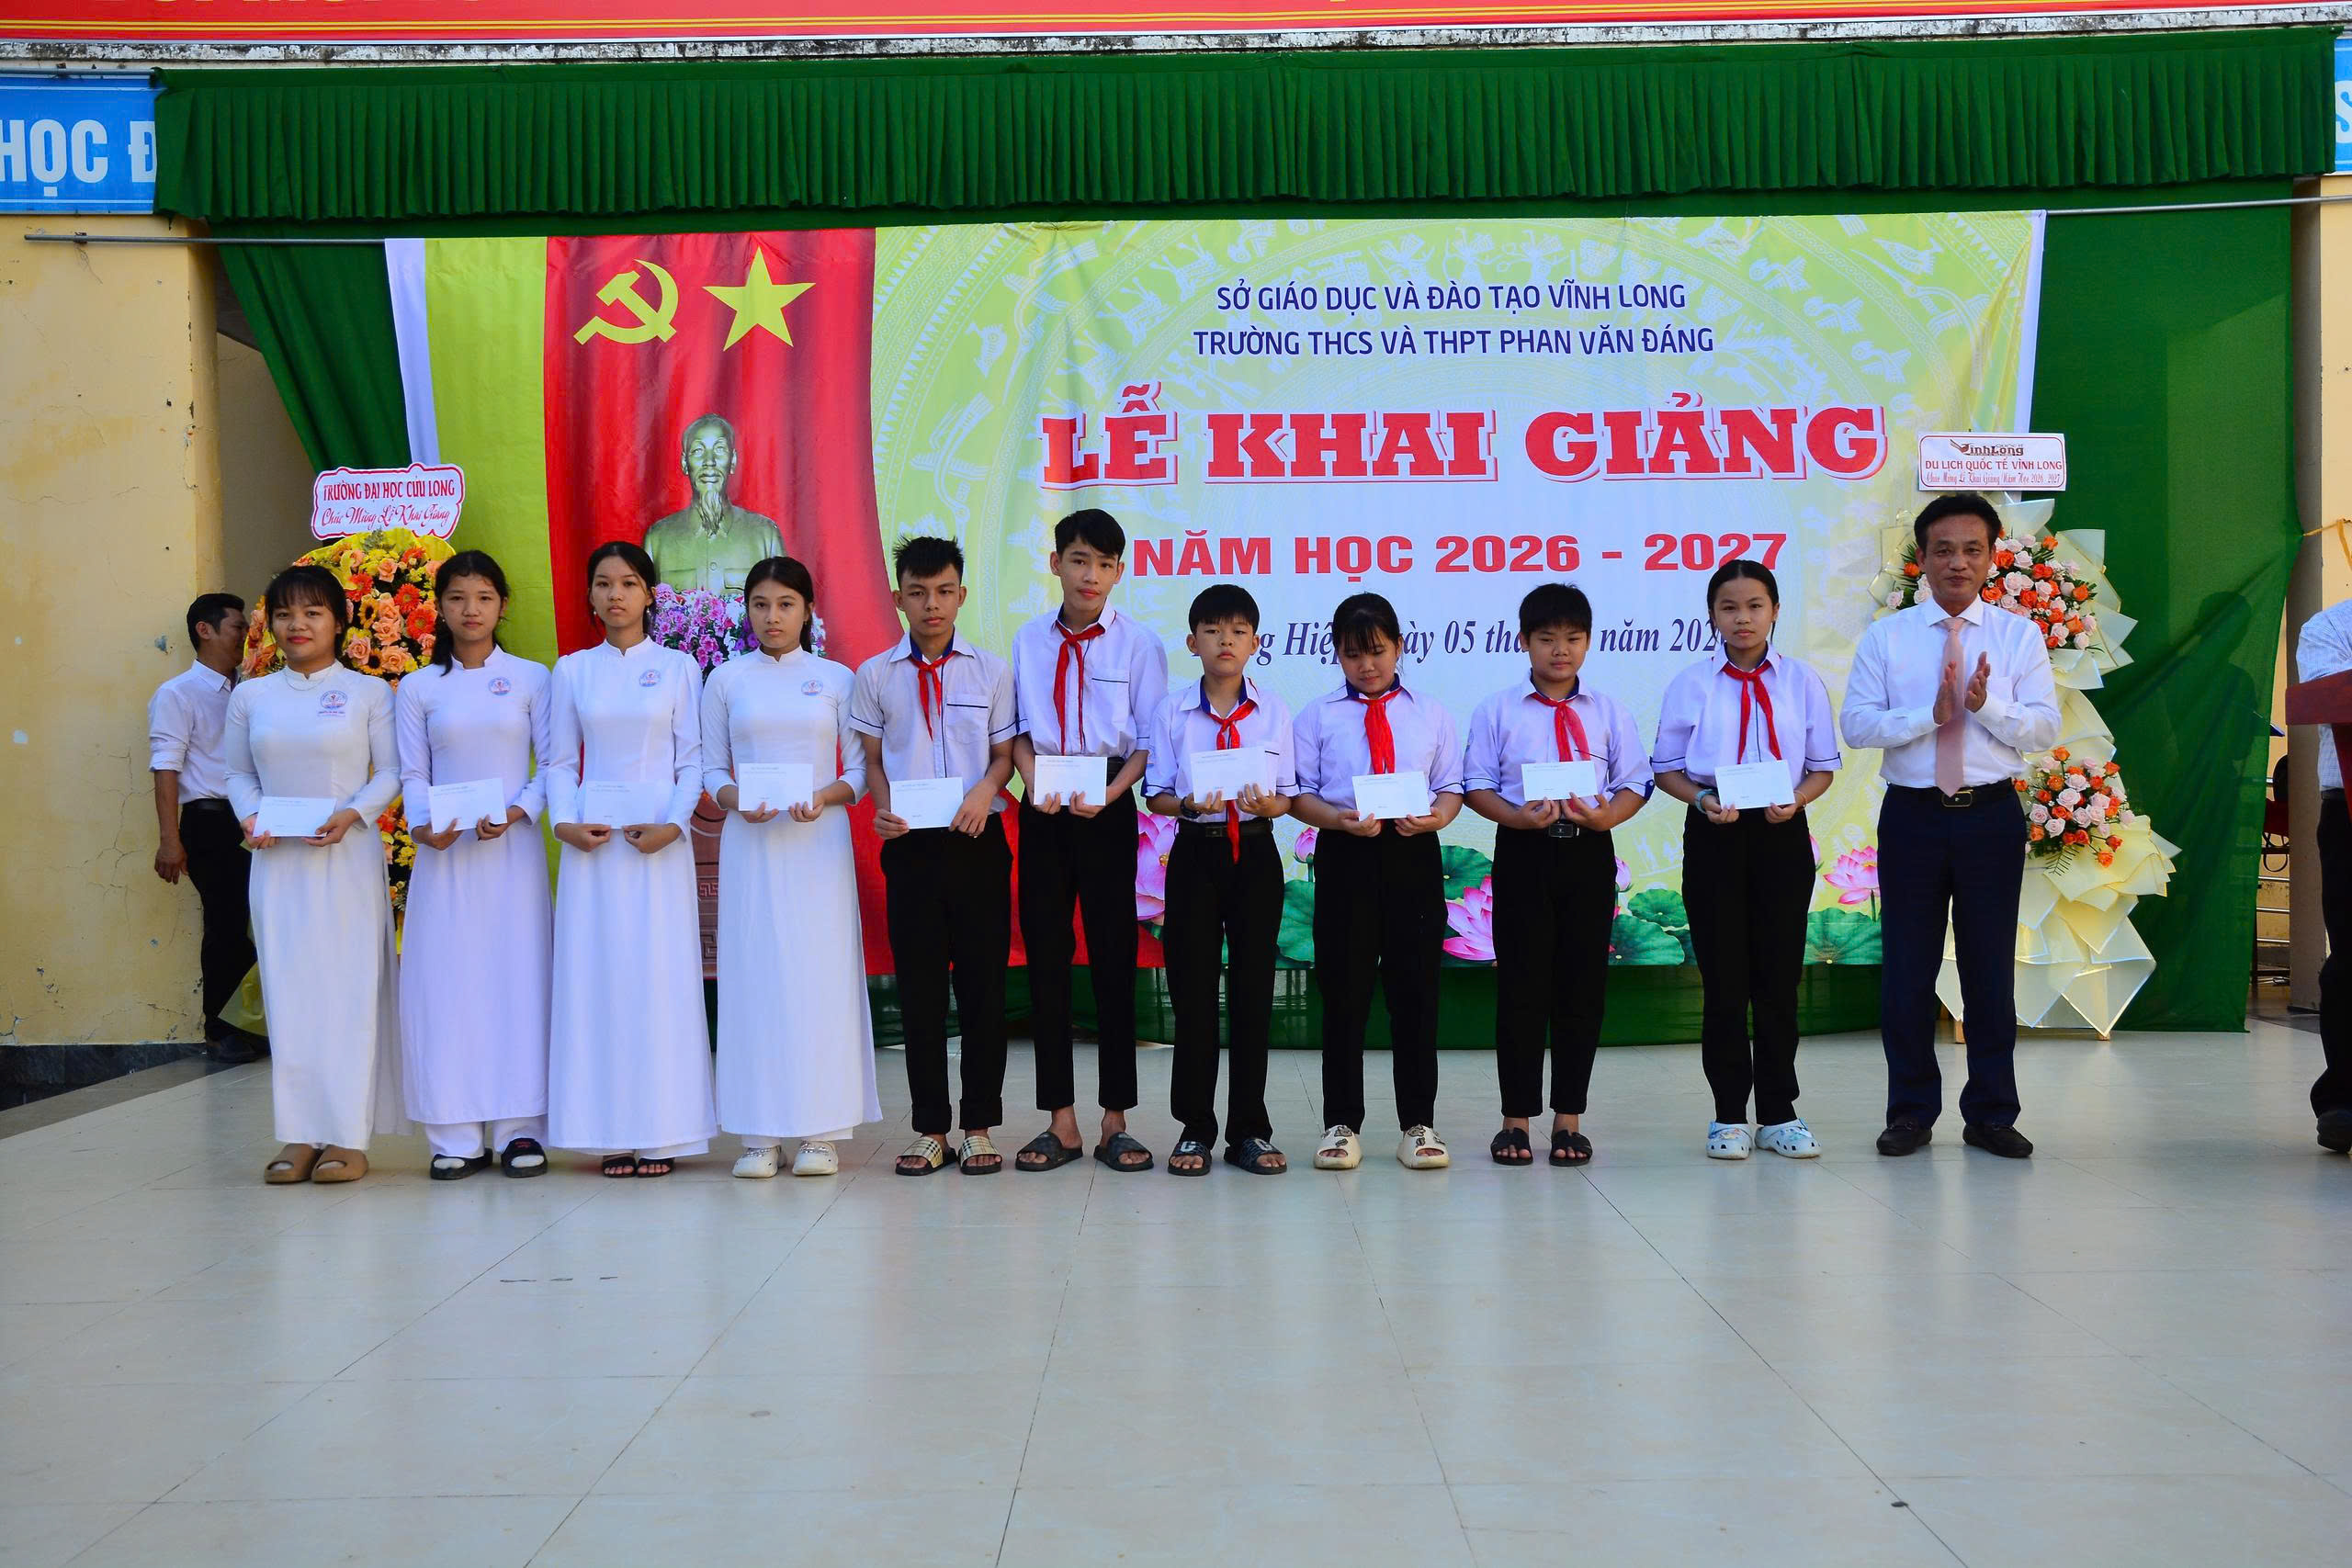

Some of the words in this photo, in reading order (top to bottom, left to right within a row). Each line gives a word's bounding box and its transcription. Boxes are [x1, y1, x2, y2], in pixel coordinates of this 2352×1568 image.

[0, 118, 109, 197] HỌC
[1217, 278, 1251, 310] SỞ
[1258, 280, 1317, 310] GIÁO
[1326, 286, 1377, 316] DỤC
[1384, 280, 1420, 310] VÀ
[1426, 280, 1482, 310] ĐÀO
[1488, 285, 1541, 315] TẠO
[1548, 278, 1611, 310] VĨNH
[1619, 284, 1686, 309] LONG
[1193, 324, 1300, 355] TRƯỜNG
[1307, 331, 1374, 355] THCS
[1380, 324, 1417, 355] VÀ
[1424, 330, 1491, 355] THPT
[1500, 329, 1572, 355] PHAN
[1579, 323, 1634, 355] VĂN
[1642, 323, 1714, 354] ĐÁNG
[1040, 381, 1178, 490] LỄ
[1204, 410, 1498, 483] KHAI
[1525, 391, 1888, 483] GIẢNG
[1925, 460, 1939, 469] DU
[2037, 460, 2063, 470] LONG
[323, 479, 363, 502] TRƯỜNG
[365, 482, 380, 503] ĐẠI
[382, 481, 403, 502] HỌC
[428, 479, 455, 497] LONG
[322, 507, 344, 526] Chúc
[1134, 529, 1272, 576] NĂM
[1295, 536, 1414, 582] HỌC
[1435, 534, 1580, 573] 2026
[1602, 550, 1623, 559] -
[1644, 533, 1787, 571] 2027
[1444, 620, 1476, 654] 05
[1600, 618, 1660, 652] năm
[1668, 618, 1716, 652] 202
